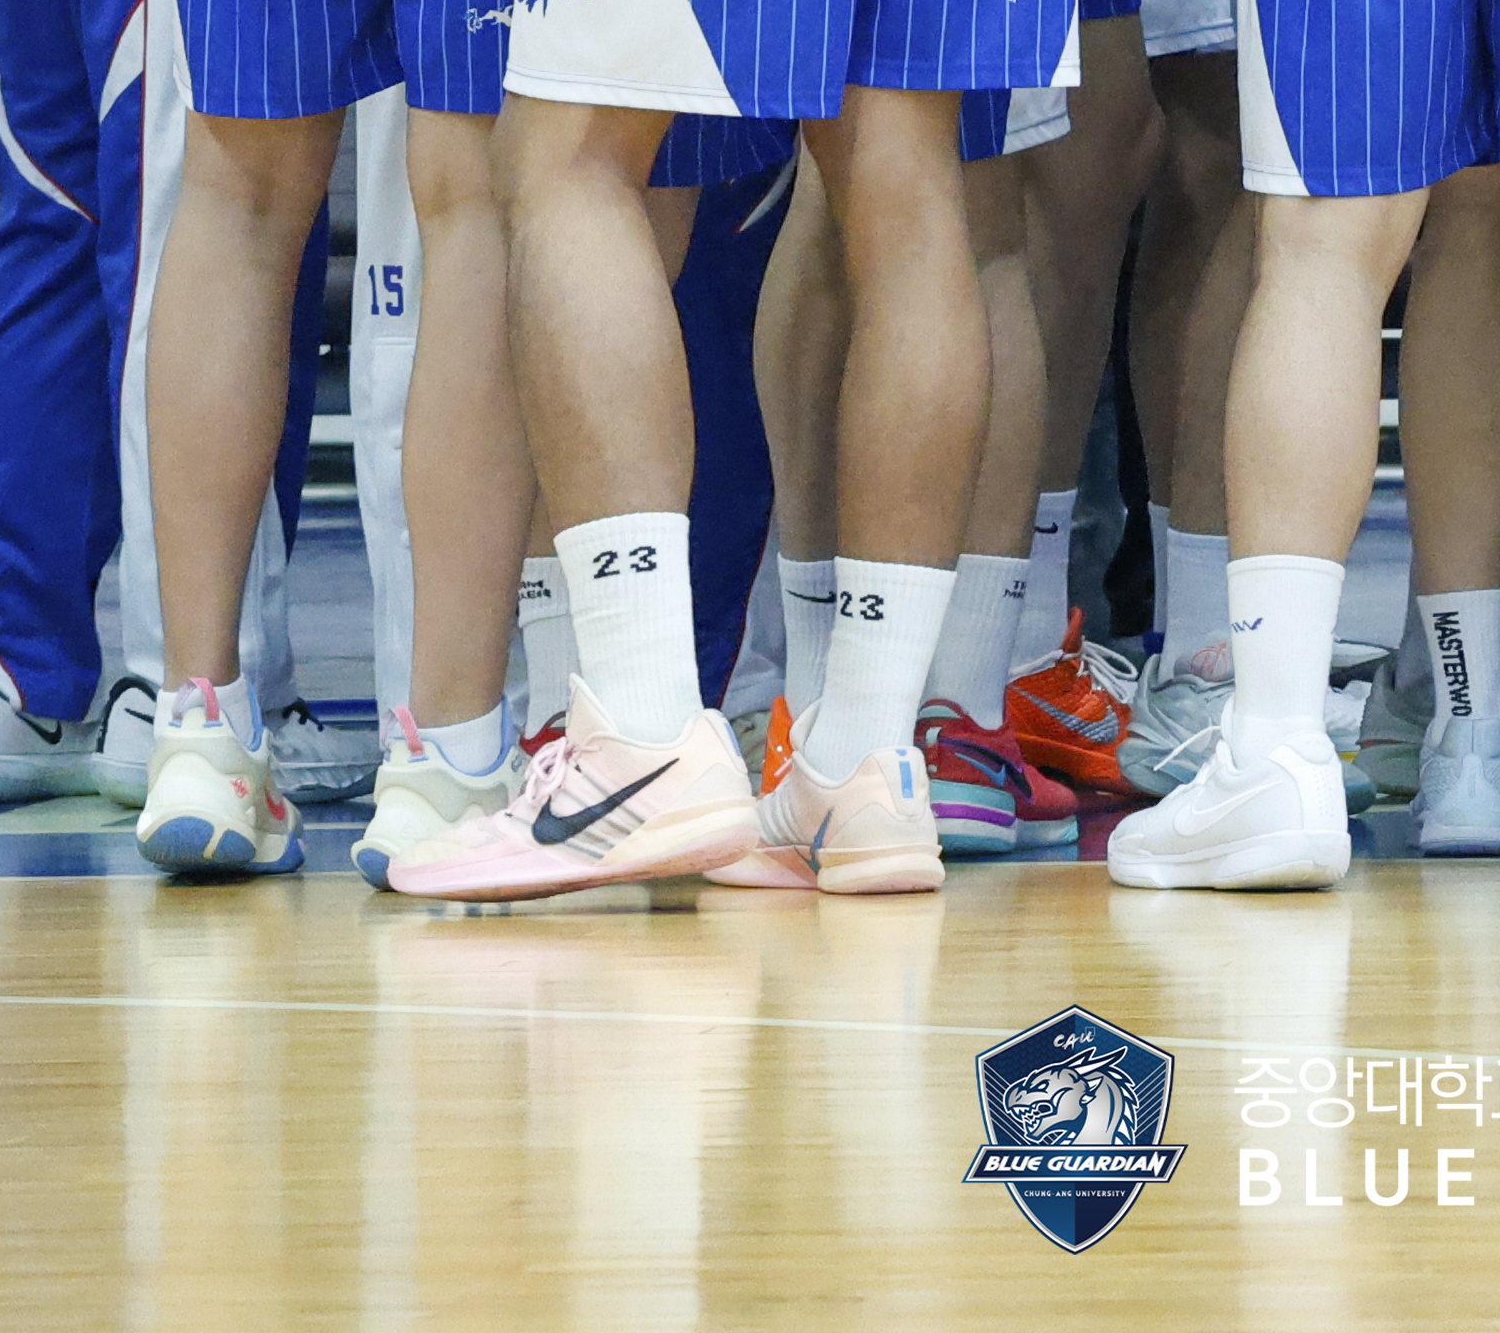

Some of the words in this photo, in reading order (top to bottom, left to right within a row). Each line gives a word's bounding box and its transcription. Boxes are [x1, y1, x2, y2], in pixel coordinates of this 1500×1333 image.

[367, 264, 404, 317] 15
[592, 545, 658, 579] 23
[839, 590, 885, 621] 23
